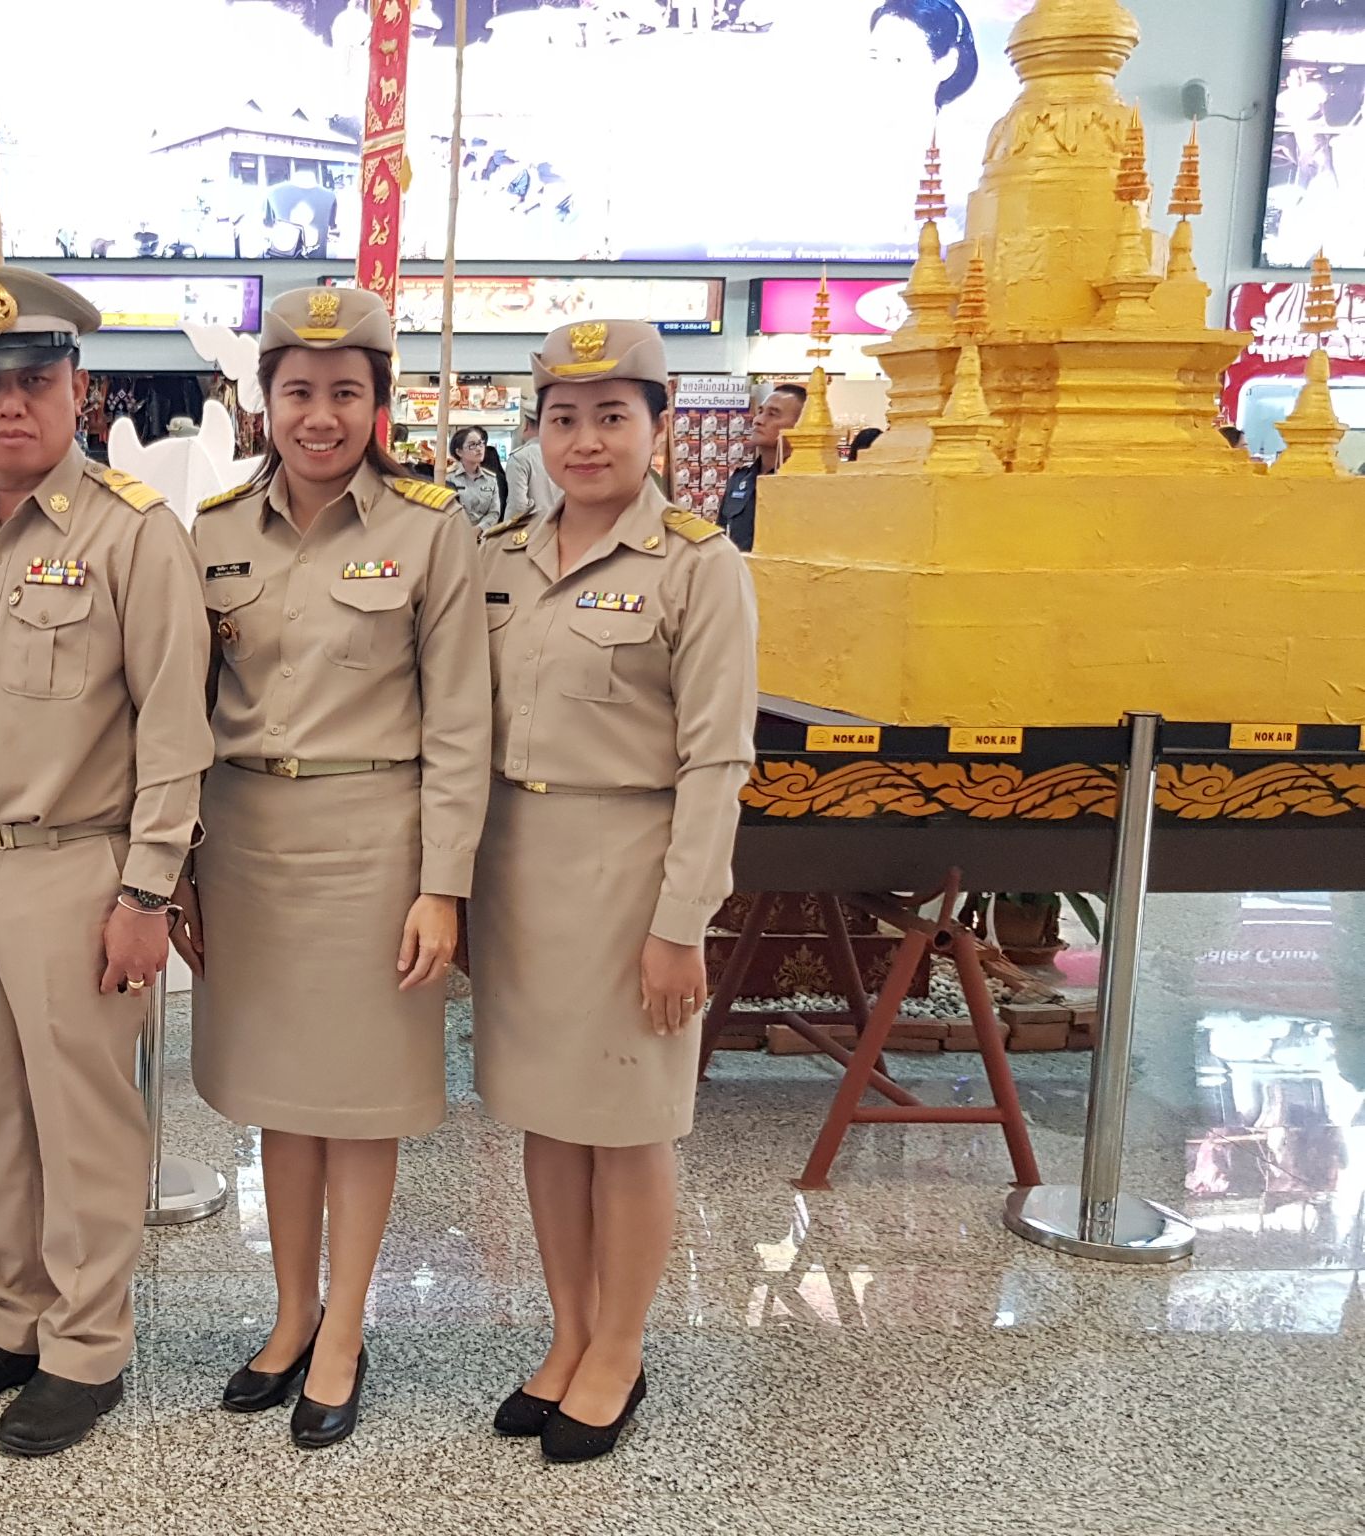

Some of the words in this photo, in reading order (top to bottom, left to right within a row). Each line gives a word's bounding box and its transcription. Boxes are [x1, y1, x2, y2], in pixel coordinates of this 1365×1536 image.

[833, 734, 856, 744] NOK
[857, 735, 875, 744] AIR
[975, 735, 997, 745] NOK
[999, 735, 1017, 745] AIR
[1254, 732, 1274, 741] NOK
[1276, 732, 1292, 742] AIR
